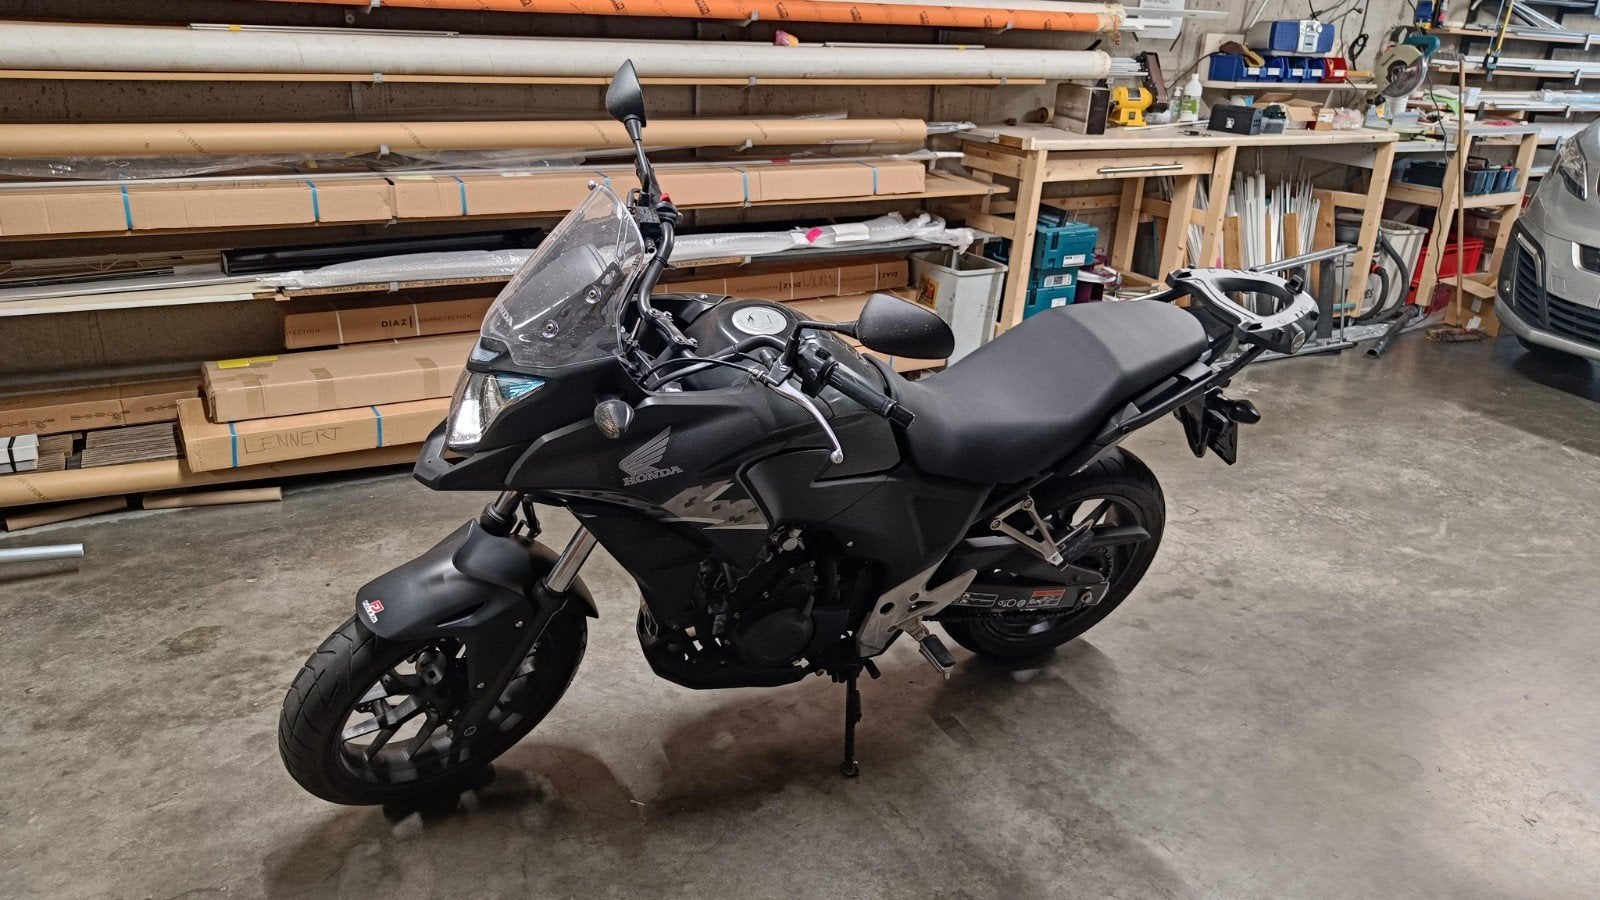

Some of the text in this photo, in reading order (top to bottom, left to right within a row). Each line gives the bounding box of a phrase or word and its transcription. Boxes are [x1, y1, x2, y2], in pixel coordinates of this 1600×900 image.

[381, 314, 472, 329] DIAZ UNPROTECTION
[287, 327, 321, 337] TECTION
[243, 426, 343, 455] LENNERT
[622, 465, 684, 487] HONDA
